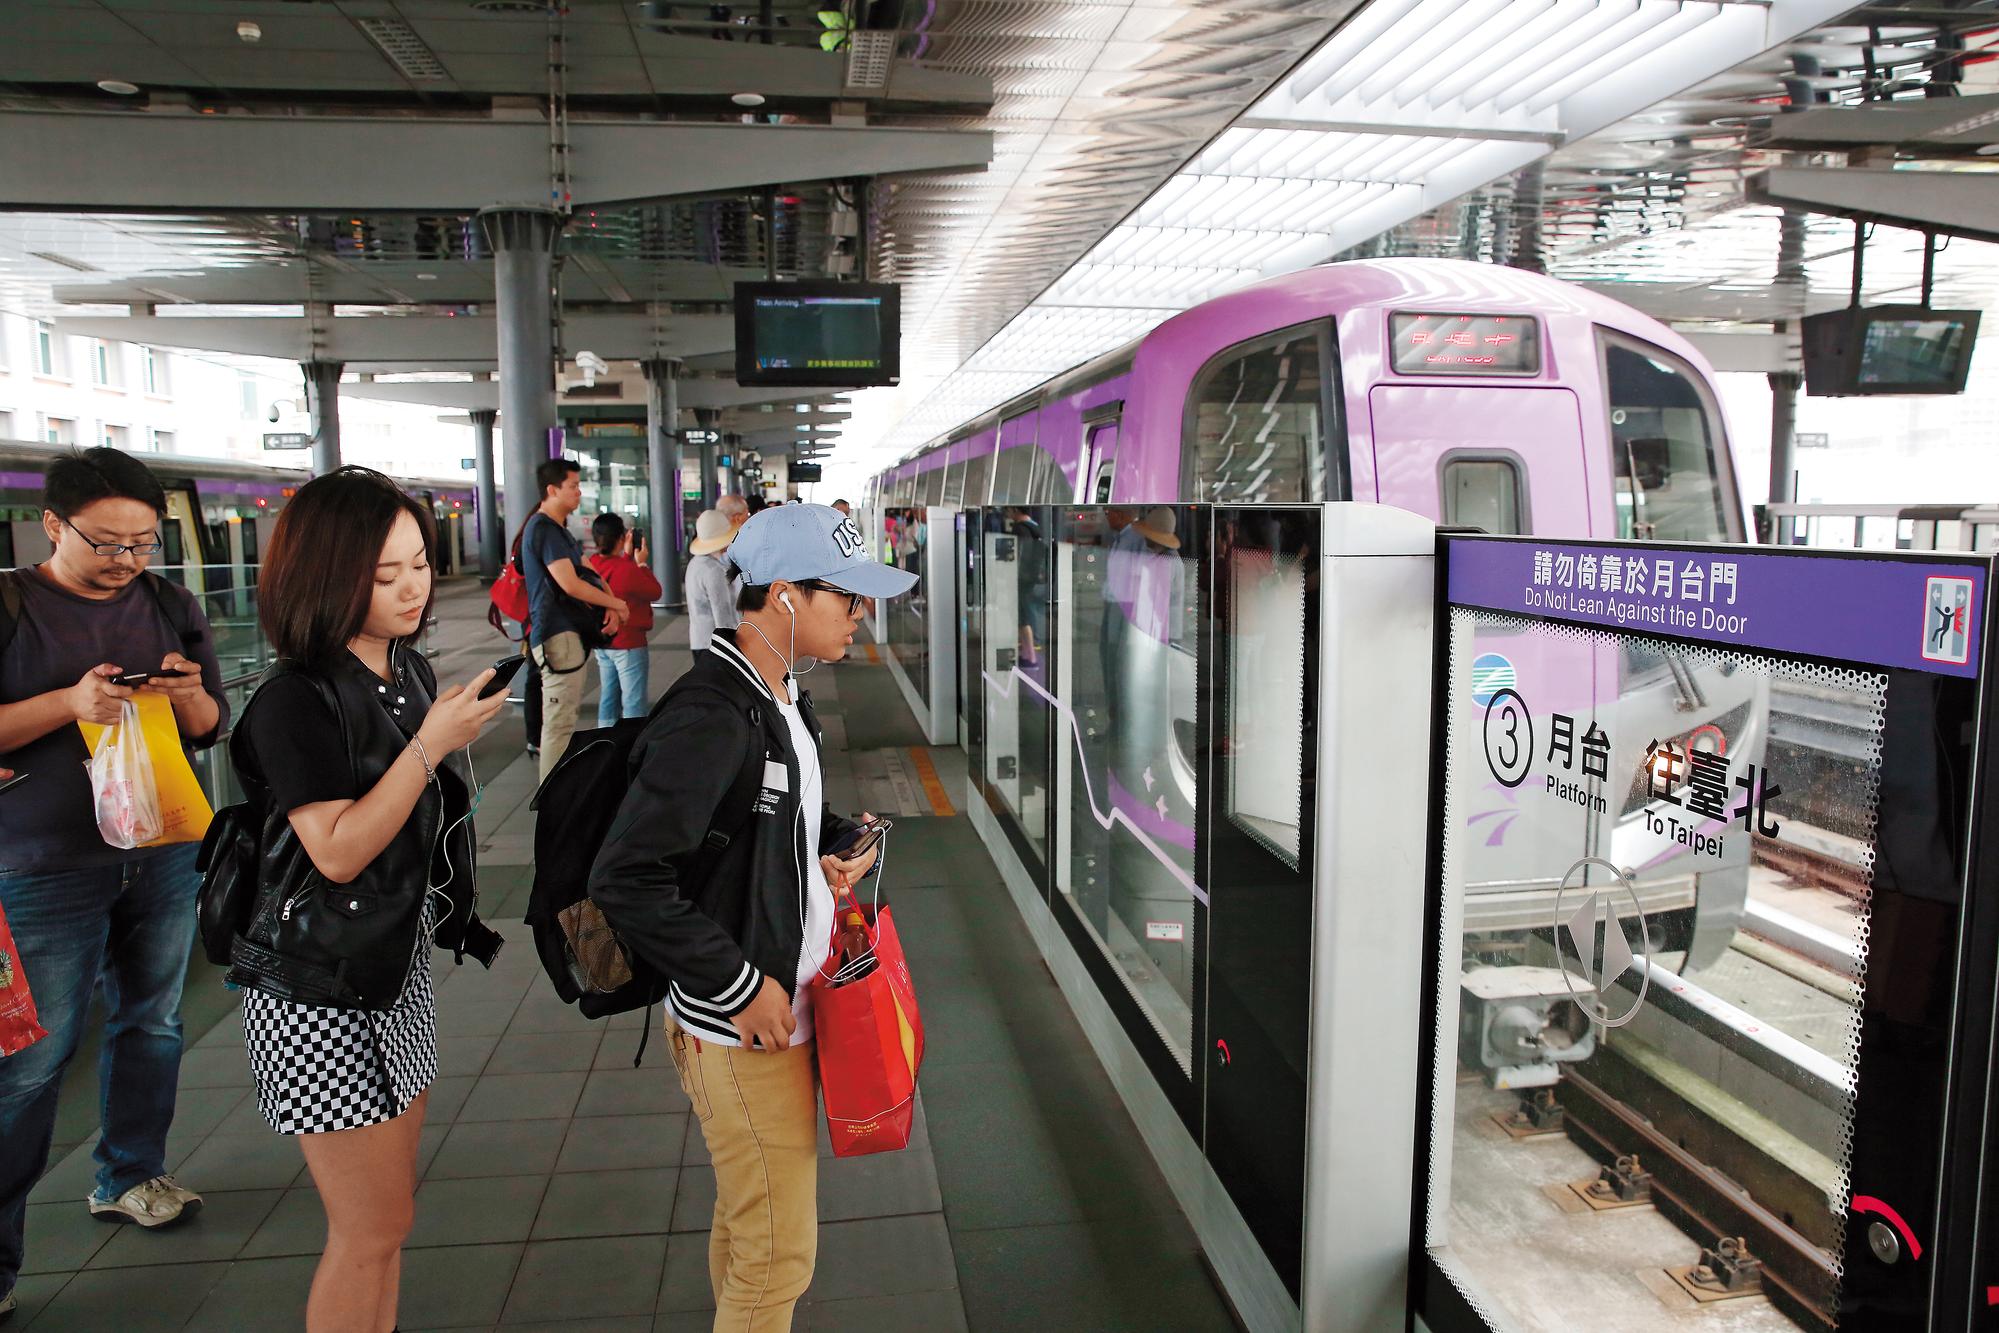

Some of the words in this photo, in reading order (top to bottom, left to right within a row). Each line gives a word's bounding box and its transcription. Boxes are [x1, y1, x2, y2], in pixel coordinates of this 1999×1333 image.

[1533, 550, 1739, 605] 請勿倚靠於月台門
[1525, 587, 1542, 607] Do
[1545, 589, 1567, 611] Not
[1570, 591, 1604, 616] Lean
[1607, 596, 1666, 624] Against
[1670, 604, 1697, 629] the
[1702, 607, 1748, 635] Door
[1546, 712, 1612, 783] 月台
[1546, 774, 1607, 814] Platform
[1644, 737, 1782, 839] 往臺北
[1643, 808, 1664, 836] To
[1667, 816, 1724, 859] Taipei
